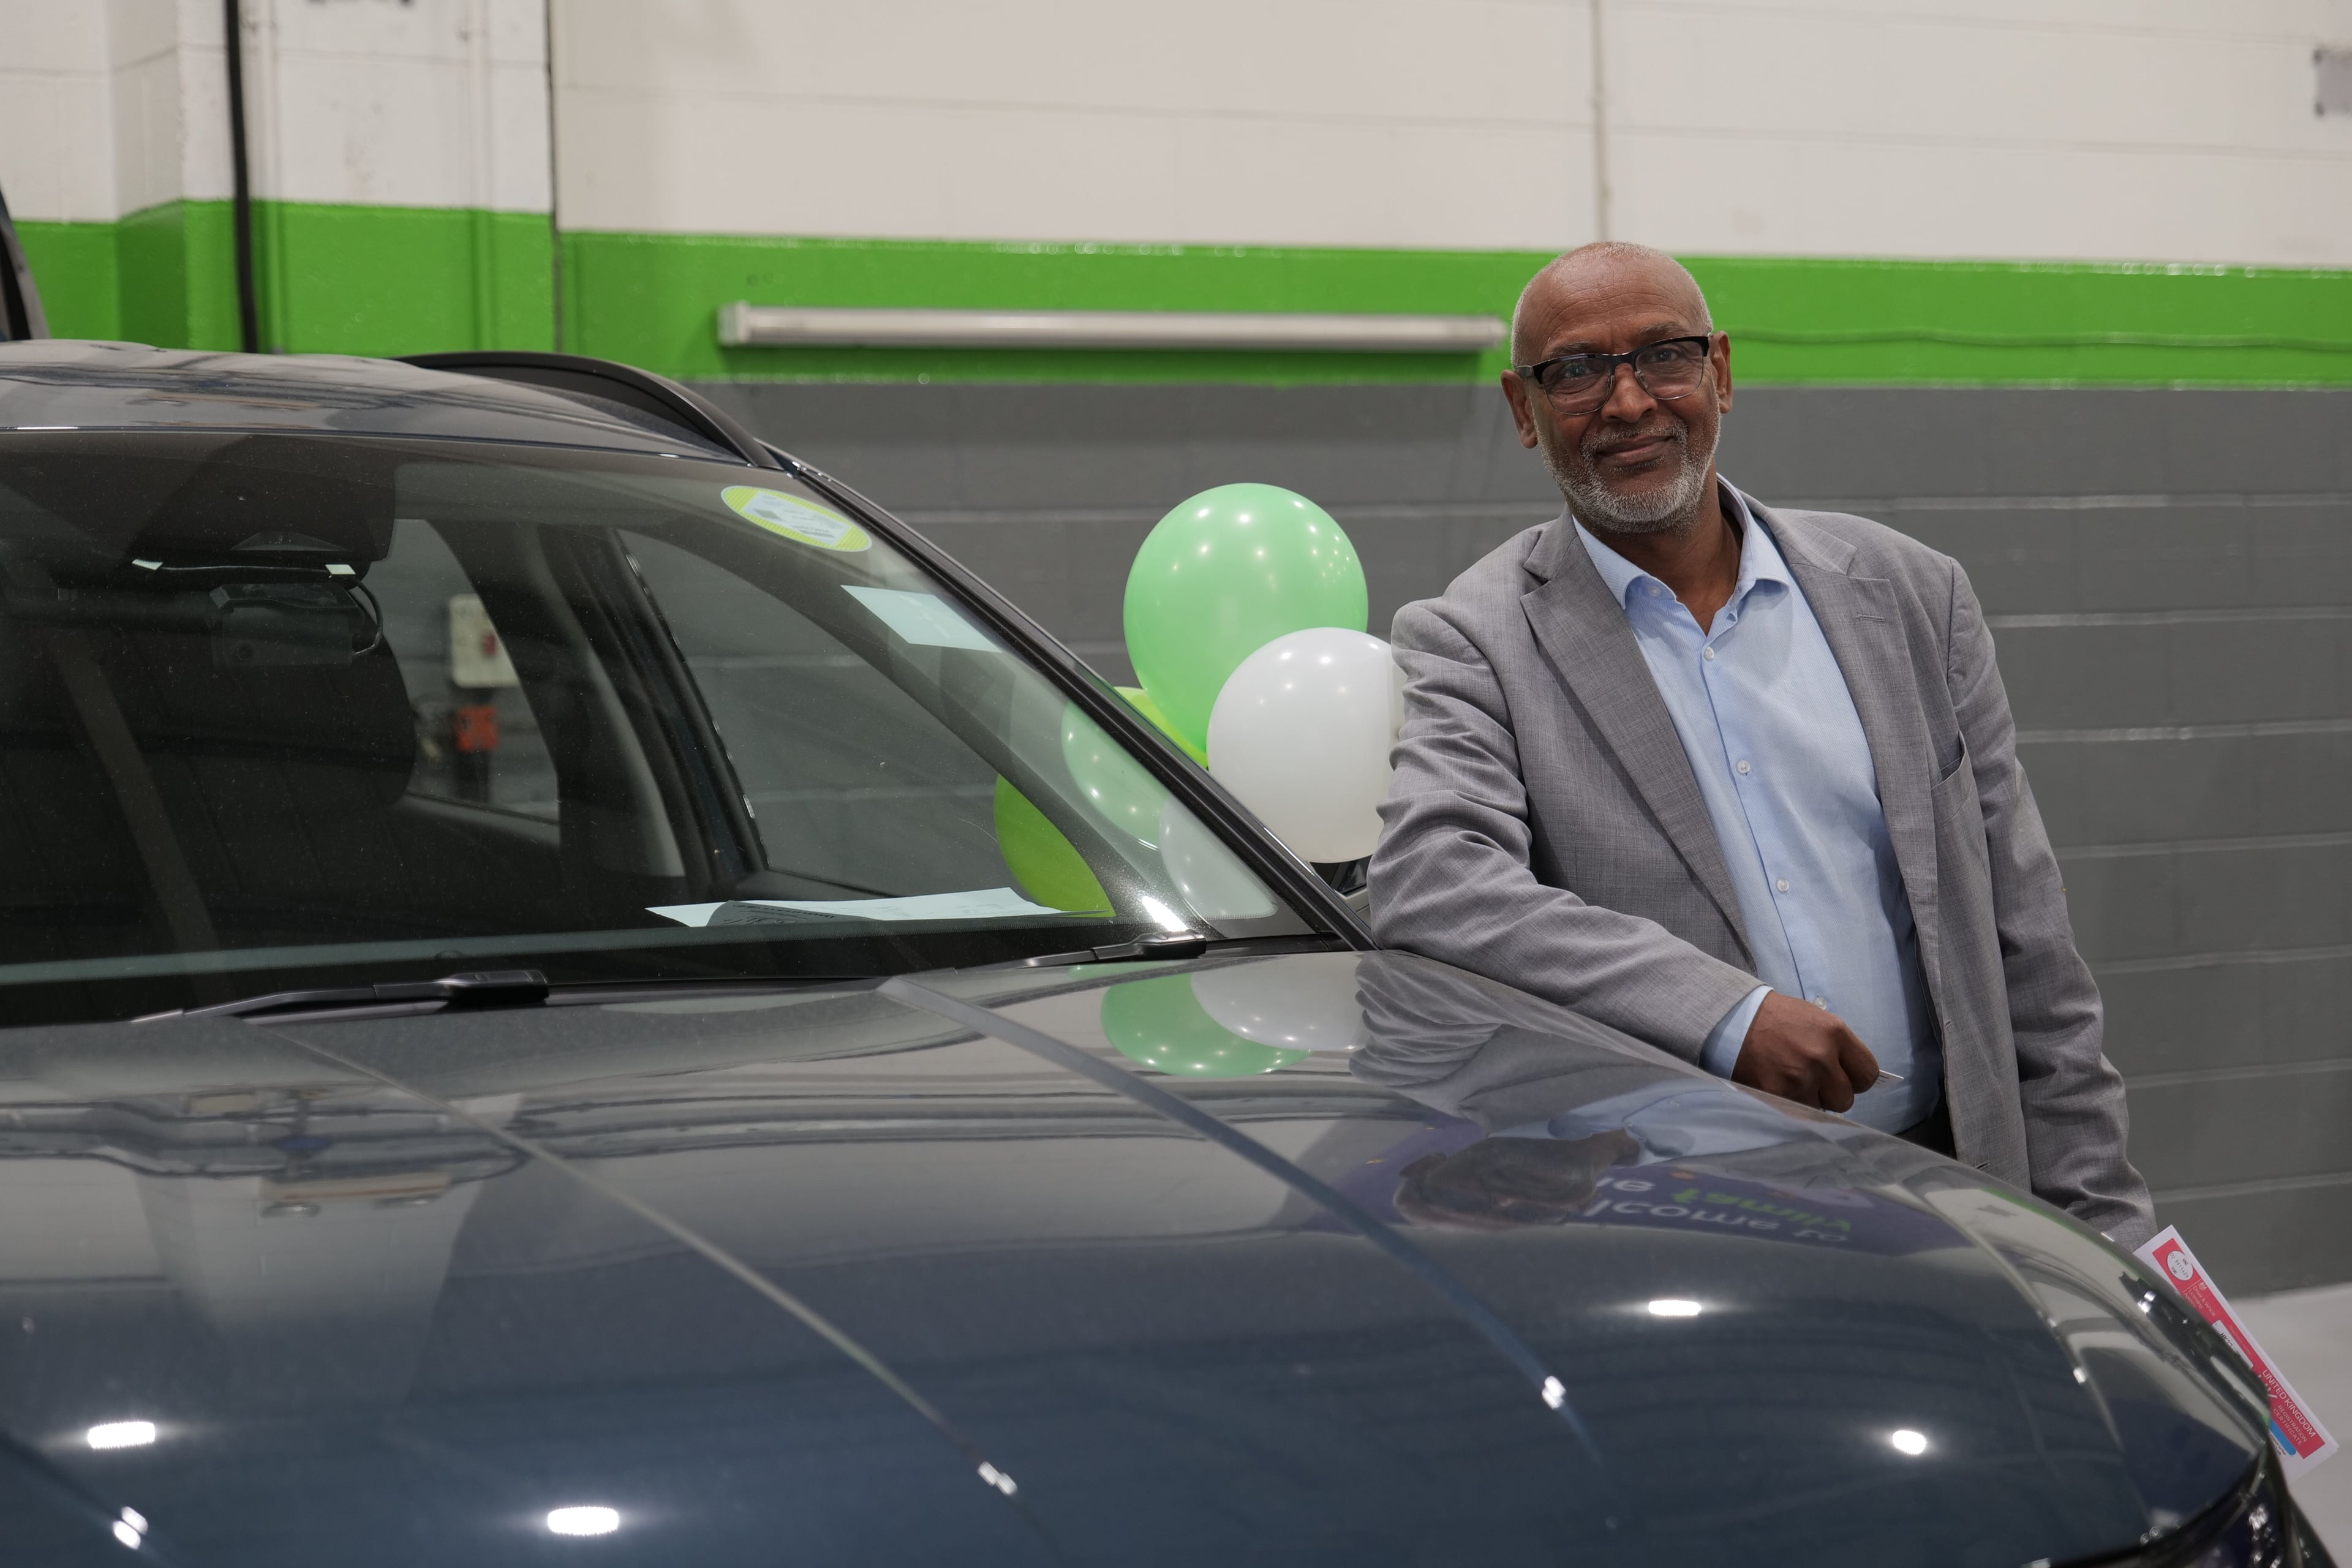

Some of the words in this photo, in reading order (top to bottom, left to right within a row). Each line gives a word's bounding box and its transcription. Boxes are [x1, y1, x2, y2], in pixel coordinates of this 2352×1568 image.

[2188, 1289, 2203, 1309] Licensing
[2193, 1286, 2203, 1298] Driver
[2204, 1302, 2216, 1316] Vehicle
[2263, 1370, 2287, 1400] UNITED
[2284, 1398, 2316, 1438] KINGDOM
[2273, 1409, 2304, 1446] CERTIFICATE
[2278, 1405, 2308, 1442] REGISTRATION
